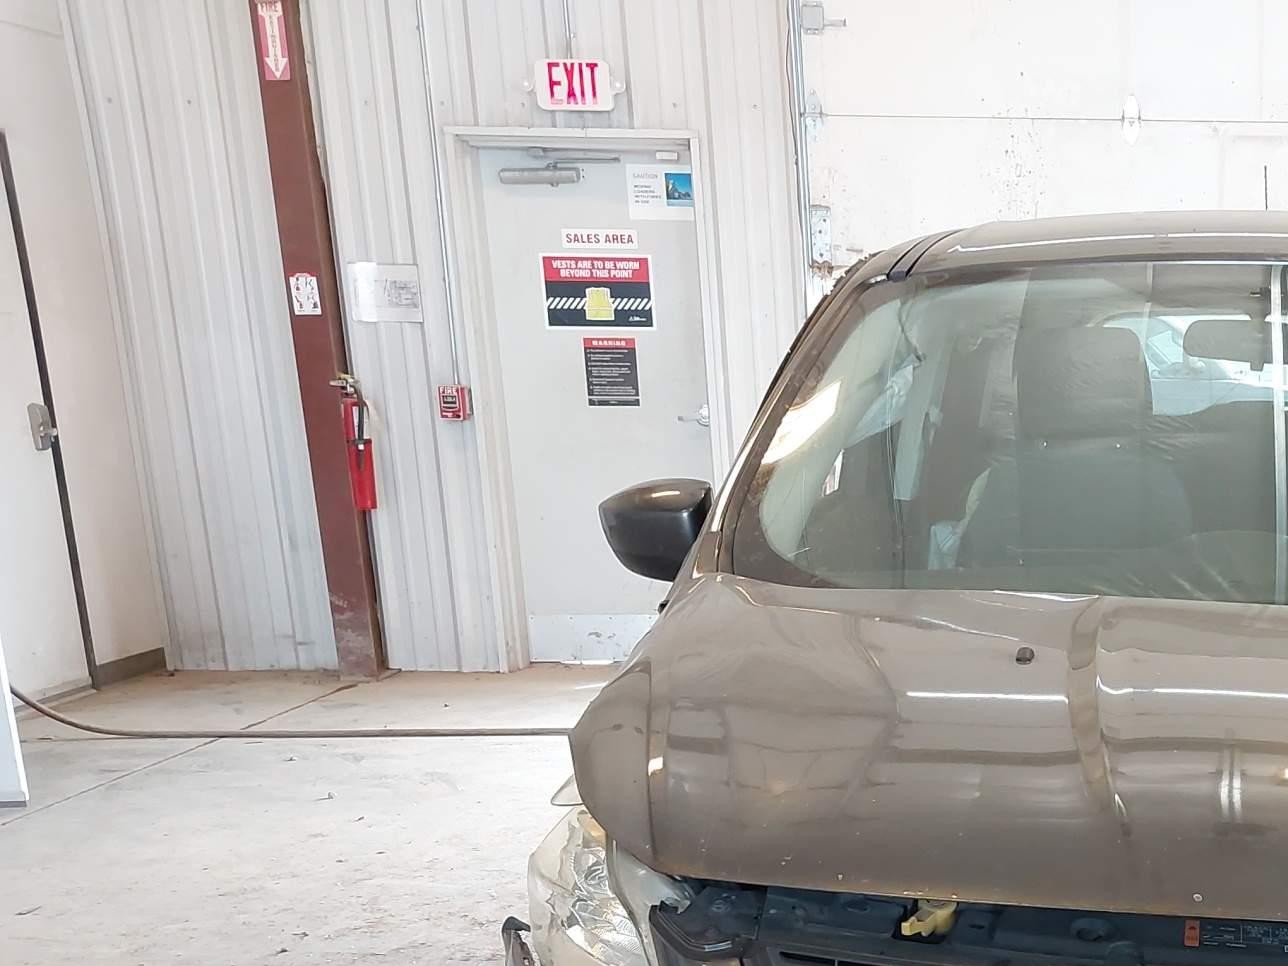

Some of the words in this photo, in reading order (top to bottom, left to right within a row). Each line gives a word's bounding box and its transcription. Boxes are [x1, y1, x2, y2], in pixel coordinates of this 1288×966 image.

[547, 62, 598, 105] EXIT
[565, 233, 600, 244] SALES
[604, 234, 634, 244] AREA
[552, 260, 576, 269] VESTS
[577, 260, 592, 269] ARE
[593, 261, 603, 269] TO
[605, 261, 615, 269] BE
[616, 261, 640, 269] WORN
[560, 269, 591, 278] BEYOND
[592, 270, 609, 278] THIS
[610, 270, 633, 278] POINT
